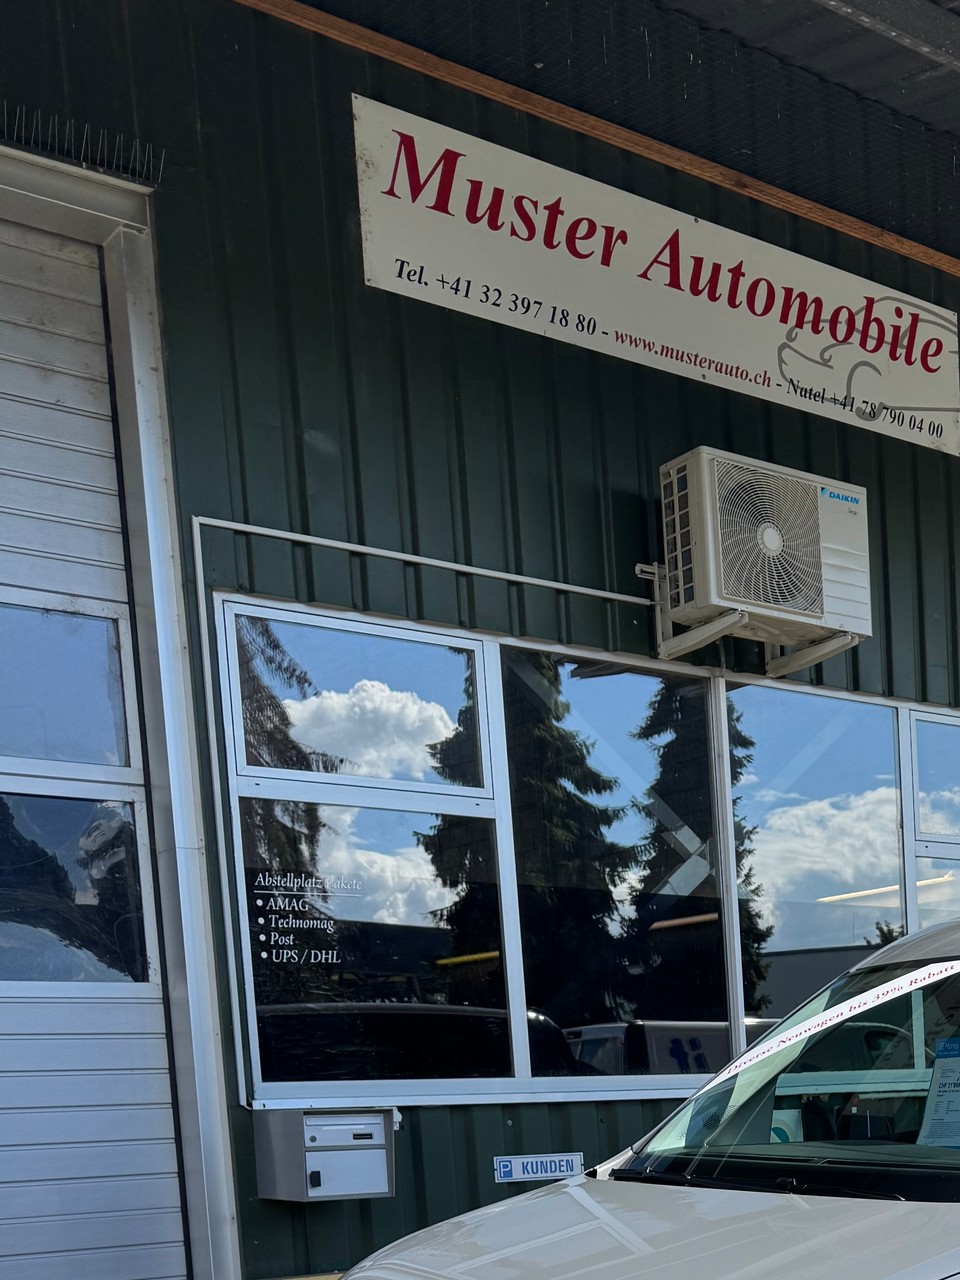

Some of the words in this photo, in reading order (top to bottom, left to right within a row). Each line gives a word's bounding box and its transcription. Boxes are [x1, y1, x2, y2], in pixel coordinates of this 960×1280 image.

[380, 129, 628, 267] Muster
[636, 228, 944, 373] Automobile
[395, 258, 429, 286] Tel.
[436, 273, 472, 299] +41
[479, 284, 502, 308] 32
[508, 293, 543, 319] 397
[548, 305, 570, 328] 18
[575, 313, 597, 336] 80
[614, 330, 771, 388] www.musterauto.ch
[787, 377, 826, 404] Natel
[829, 392, 855, 413] +41
[861, 400, 877, 419] 78
[882, 406, 905, 427] 790
[908, 414, 924, 433] 04
[928, 420, 943, 438] 00
[829, 491, 860, 505] DAIKIN
[255, 872, 322, 890] Abstellplatz
[325, 875, 362, 890] Pakete
[266, 898, 309, 911] AMAG
[268, 914, 335, 933] Technomag
[270, 932, 295, 945] Post
[272, 950, 298, 963] UPS
[310, 950, 341, 963] DHL
[727, 1046, 773, 1075] Diverse
[777, 1012, 844, 1047] Neuwagen
[849, 1000, 868, 1012] bis
[909, 965, 955, 986] Rabatt
[521, 1158, 574, 1175] KUNDEN
